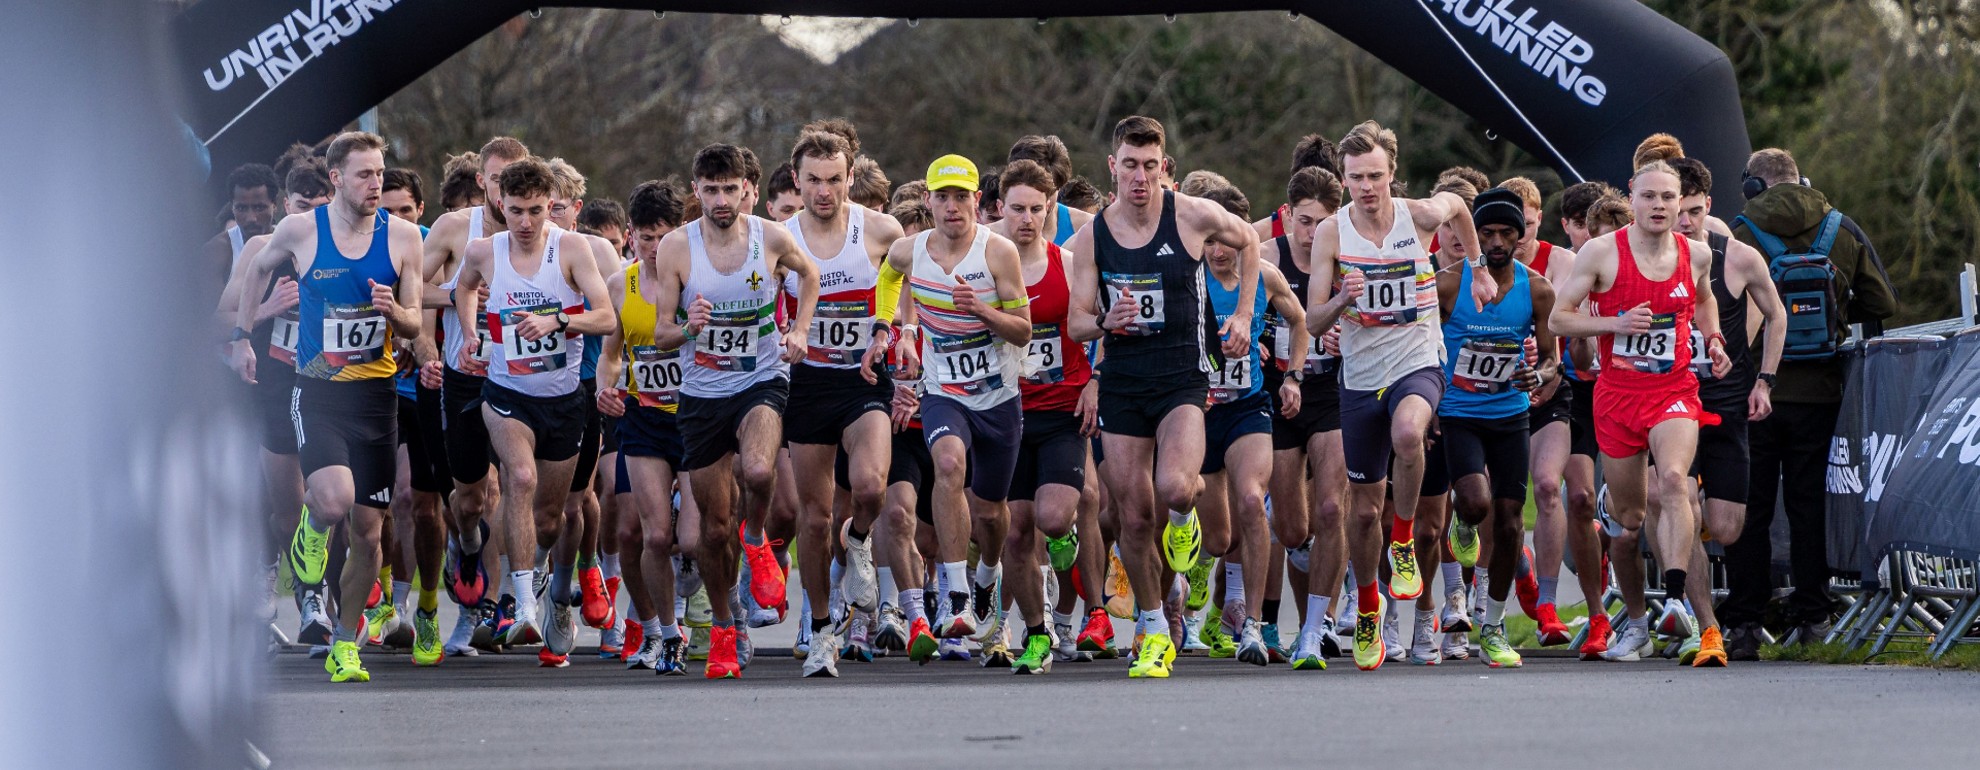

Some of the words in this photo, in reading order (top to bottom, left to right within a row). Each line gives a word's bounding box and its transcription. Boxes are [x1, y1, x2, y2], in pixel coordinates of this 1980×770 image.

[1484, 0, 1593, 63] LLED
[256, 46, 303, 89] IN
[303, 0, 401, 57] RUN
[1431, 0, 1606, 106] UNNING
[938, 165, 968, 176] HOKA
[1393, 237, 1415, 250] HOKA
[820, 270, 846, 281] RISTOL
[962, 272, 985, 281] HOKA
[1389, 265, 1412, 273] CLASSIC
[820, 279, 841, 288] WEST
[713, 298, 763, 310] KEFIELD
[1369, 282, 1406, 308] 101
[336, 320, 379, 348] 167
[708, 329, 749, 353] 134
[819, 321, 860, 347] 105
[963, 335, 987, 343] CLASSIC
[1625, 333, 1667, 355] 103
[639, 362, 682, 388] 200
[946, 350, 990, 380] 104
[1467, 354, 1512, 378] 107
[928, 425, 950, 444] HOKA
[1347, 469, 1366, 479] OKA
